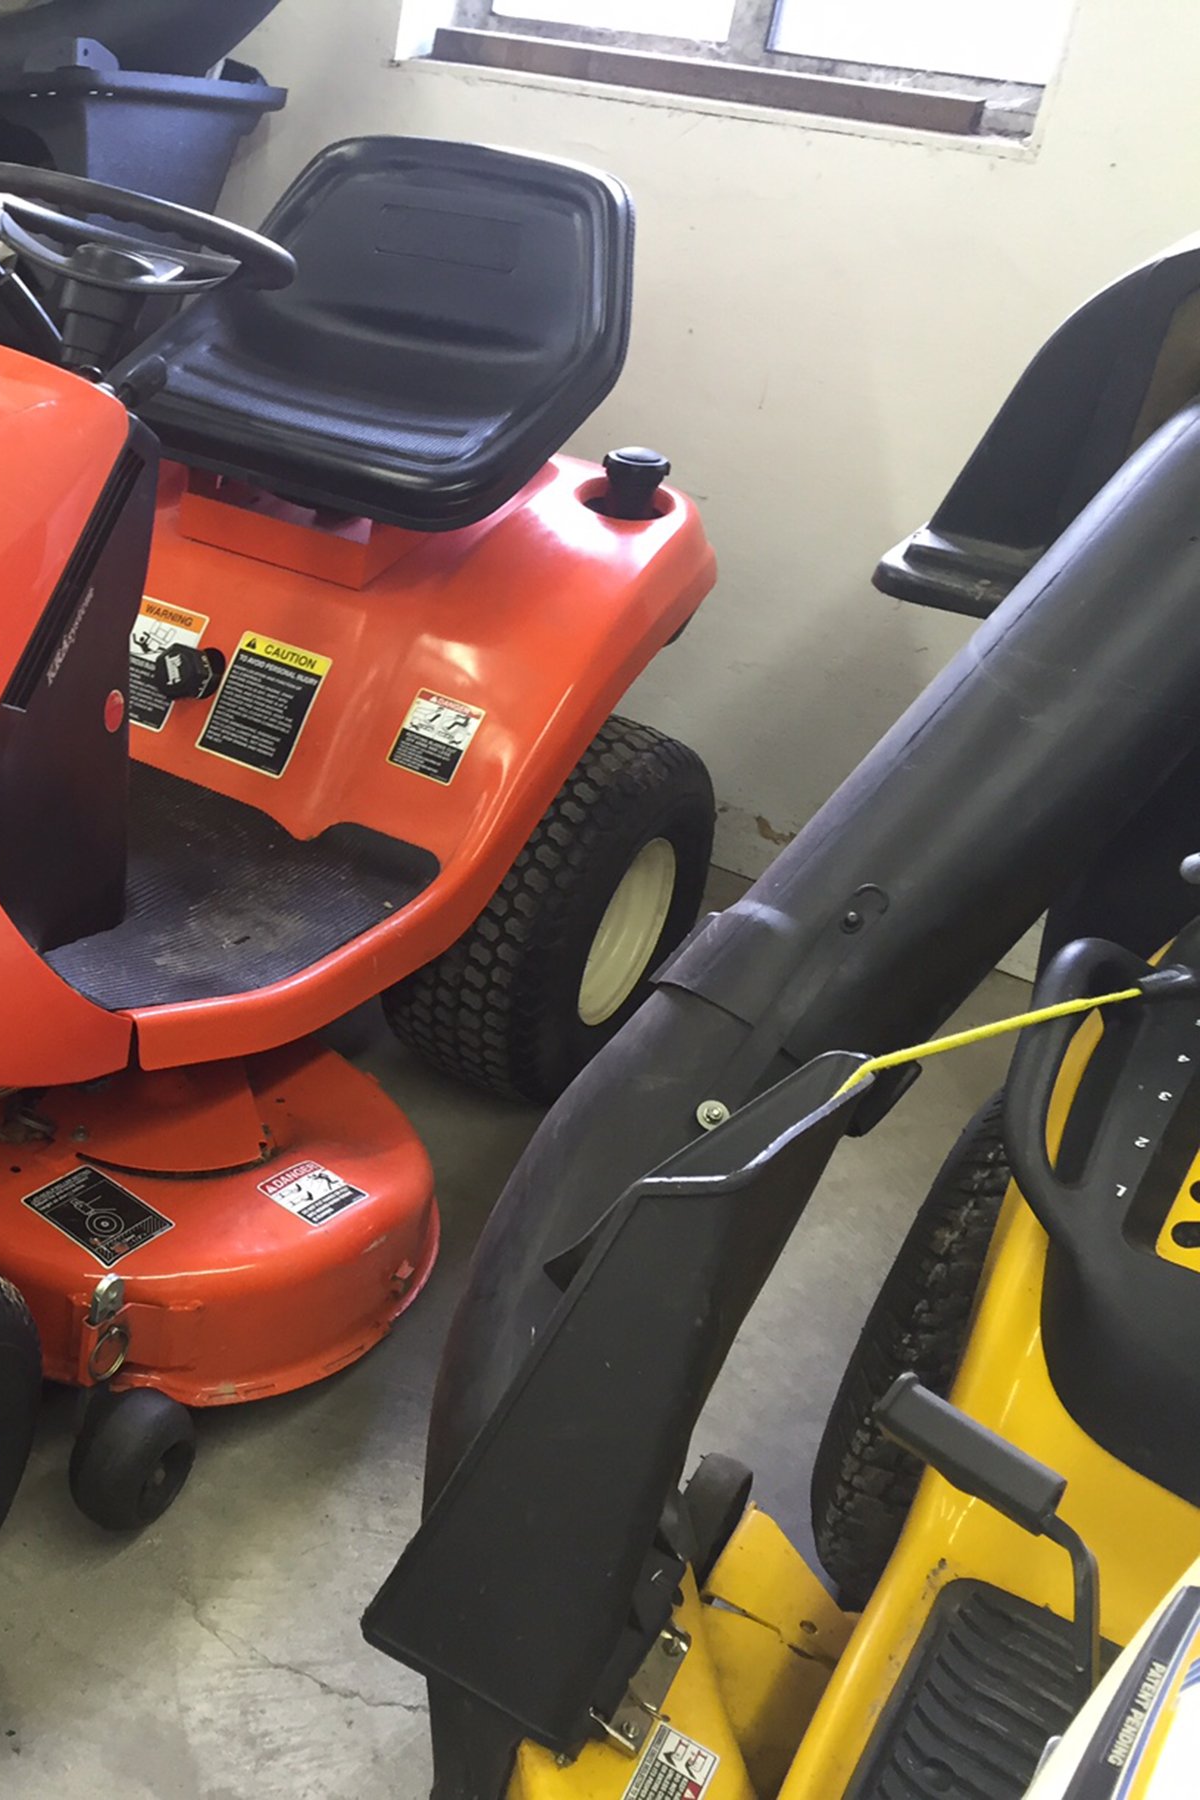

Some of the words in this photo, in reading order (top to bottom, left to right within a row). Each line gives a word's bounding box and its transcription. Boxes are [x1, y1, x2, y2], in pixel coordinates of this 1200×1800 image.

[146, 604, 193, 627] WARNING
[264, 643, 317, 669] CAUTION
[1134, 1136, 1150, 1148] 2
[273, 1163, 319, 1187] DANGER
[1134, 1661, 1166, 1709] PATENT
[1107, 1708, 1145, 1767] PENDING
